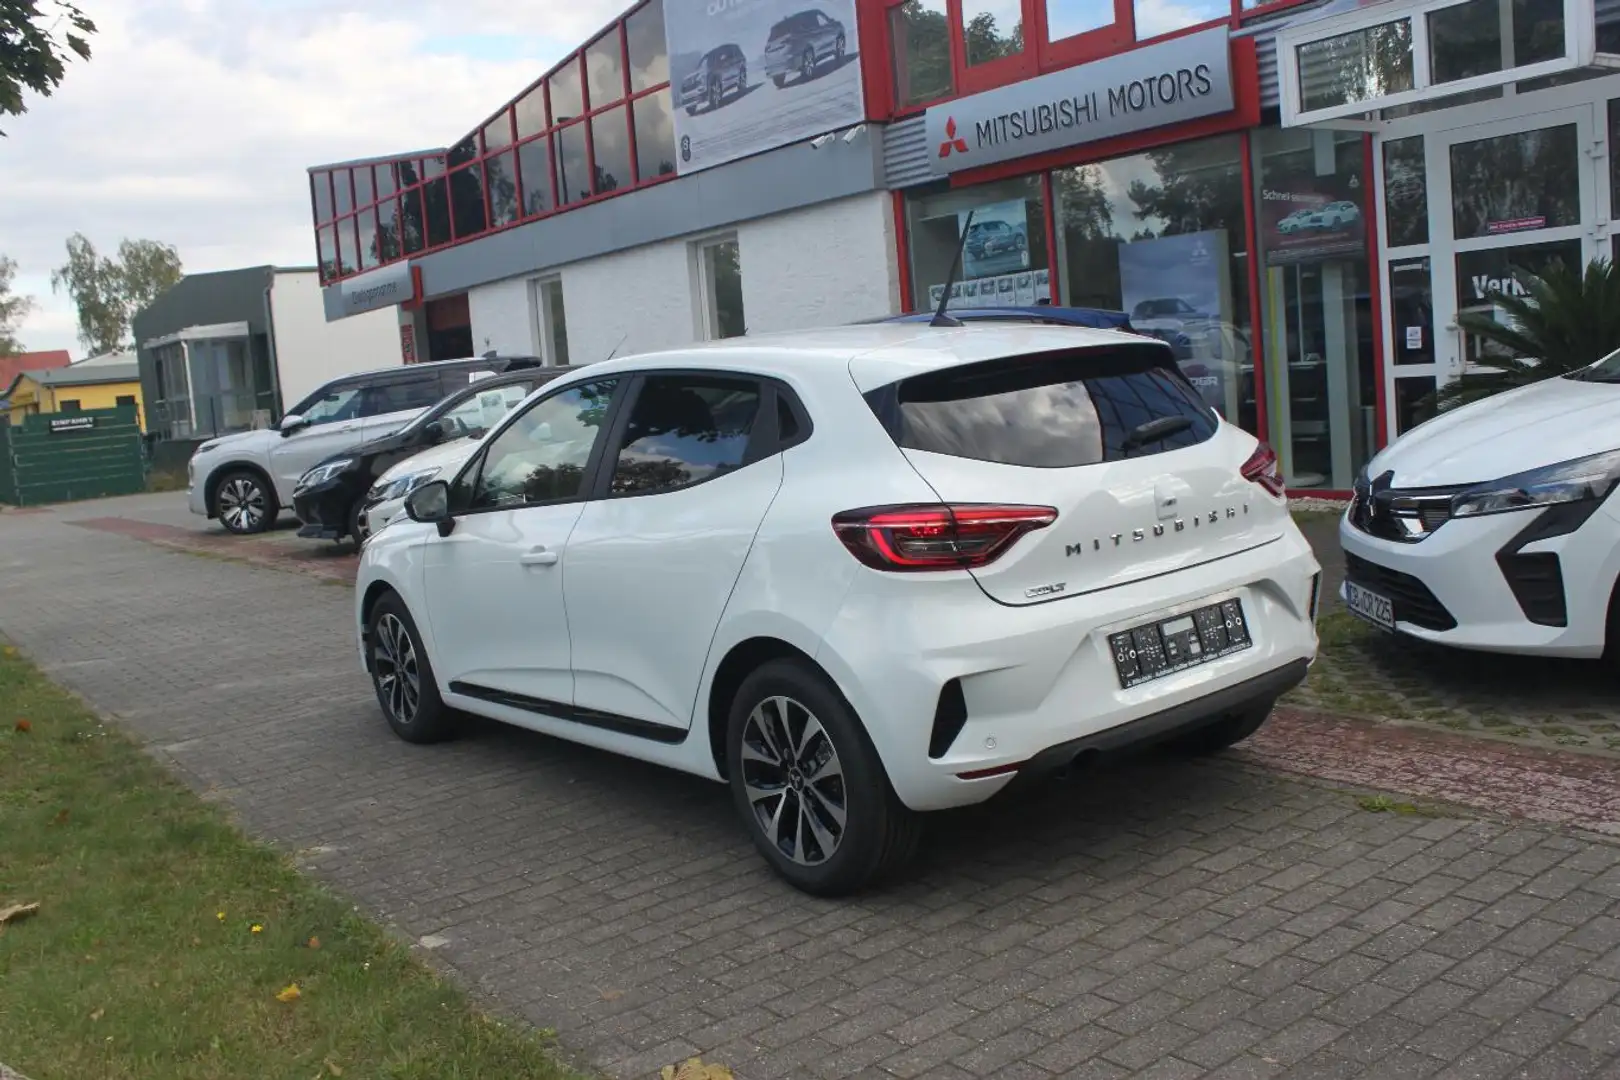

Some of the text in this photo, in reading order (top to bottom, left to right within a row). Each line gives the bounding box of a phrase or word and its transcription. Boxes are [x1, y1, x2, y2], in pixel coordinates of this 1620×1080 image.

[976, 64, 1212, 148] MITSUBISHI MOTORS
[1472, 273, 1531, 299] Verk
[1065, 504, 1249, 557] MITSUBISHI
